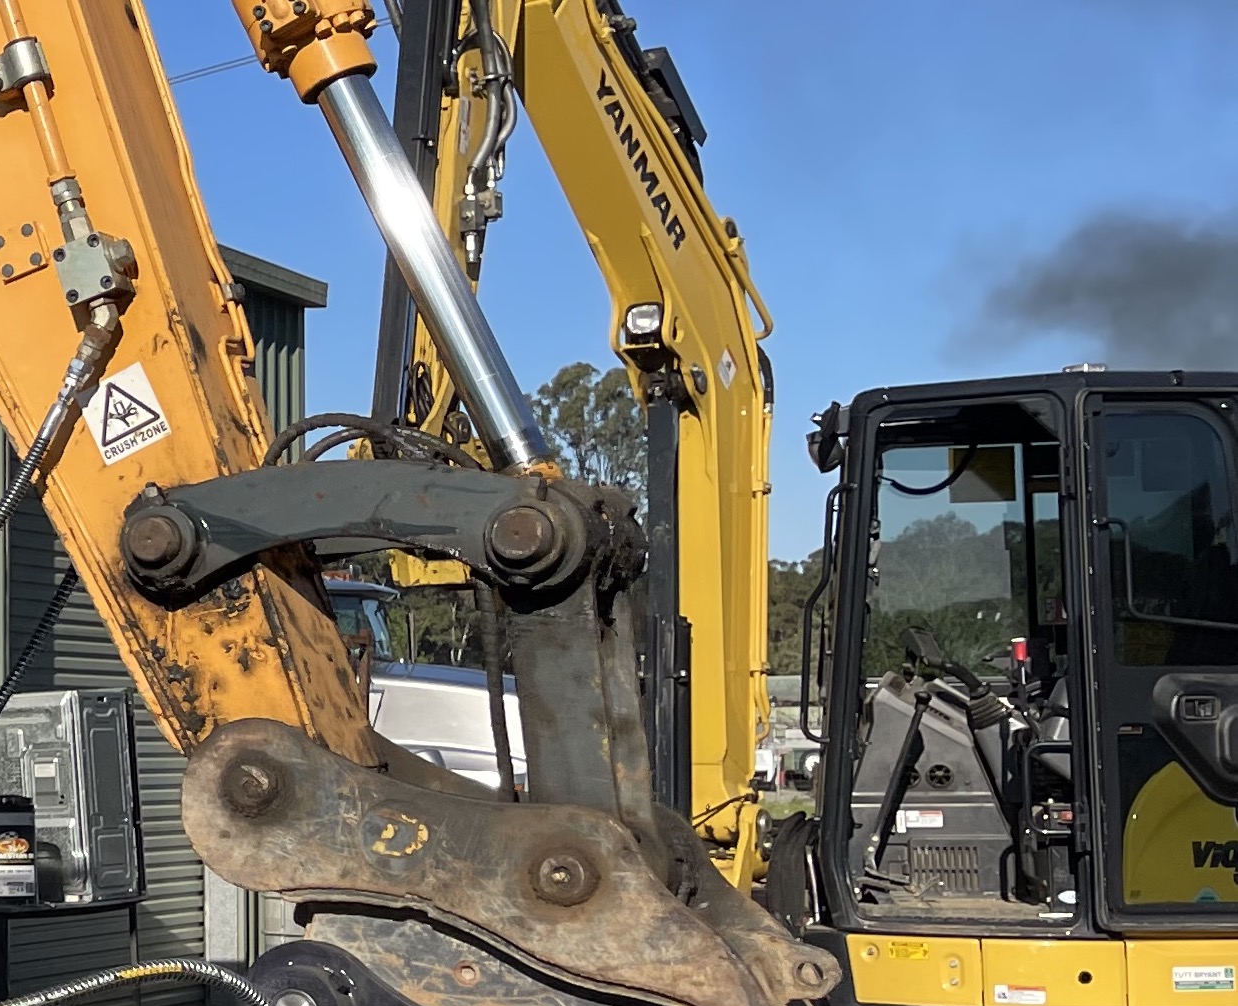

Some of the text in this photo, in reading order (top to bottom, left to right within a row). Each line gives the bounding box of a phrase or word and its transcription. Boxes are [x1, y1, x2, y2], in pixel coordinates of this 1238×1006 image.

[596, 67, 686, 251] YANMAR
[104, 421, 168, 460] CRUSH ZONE
